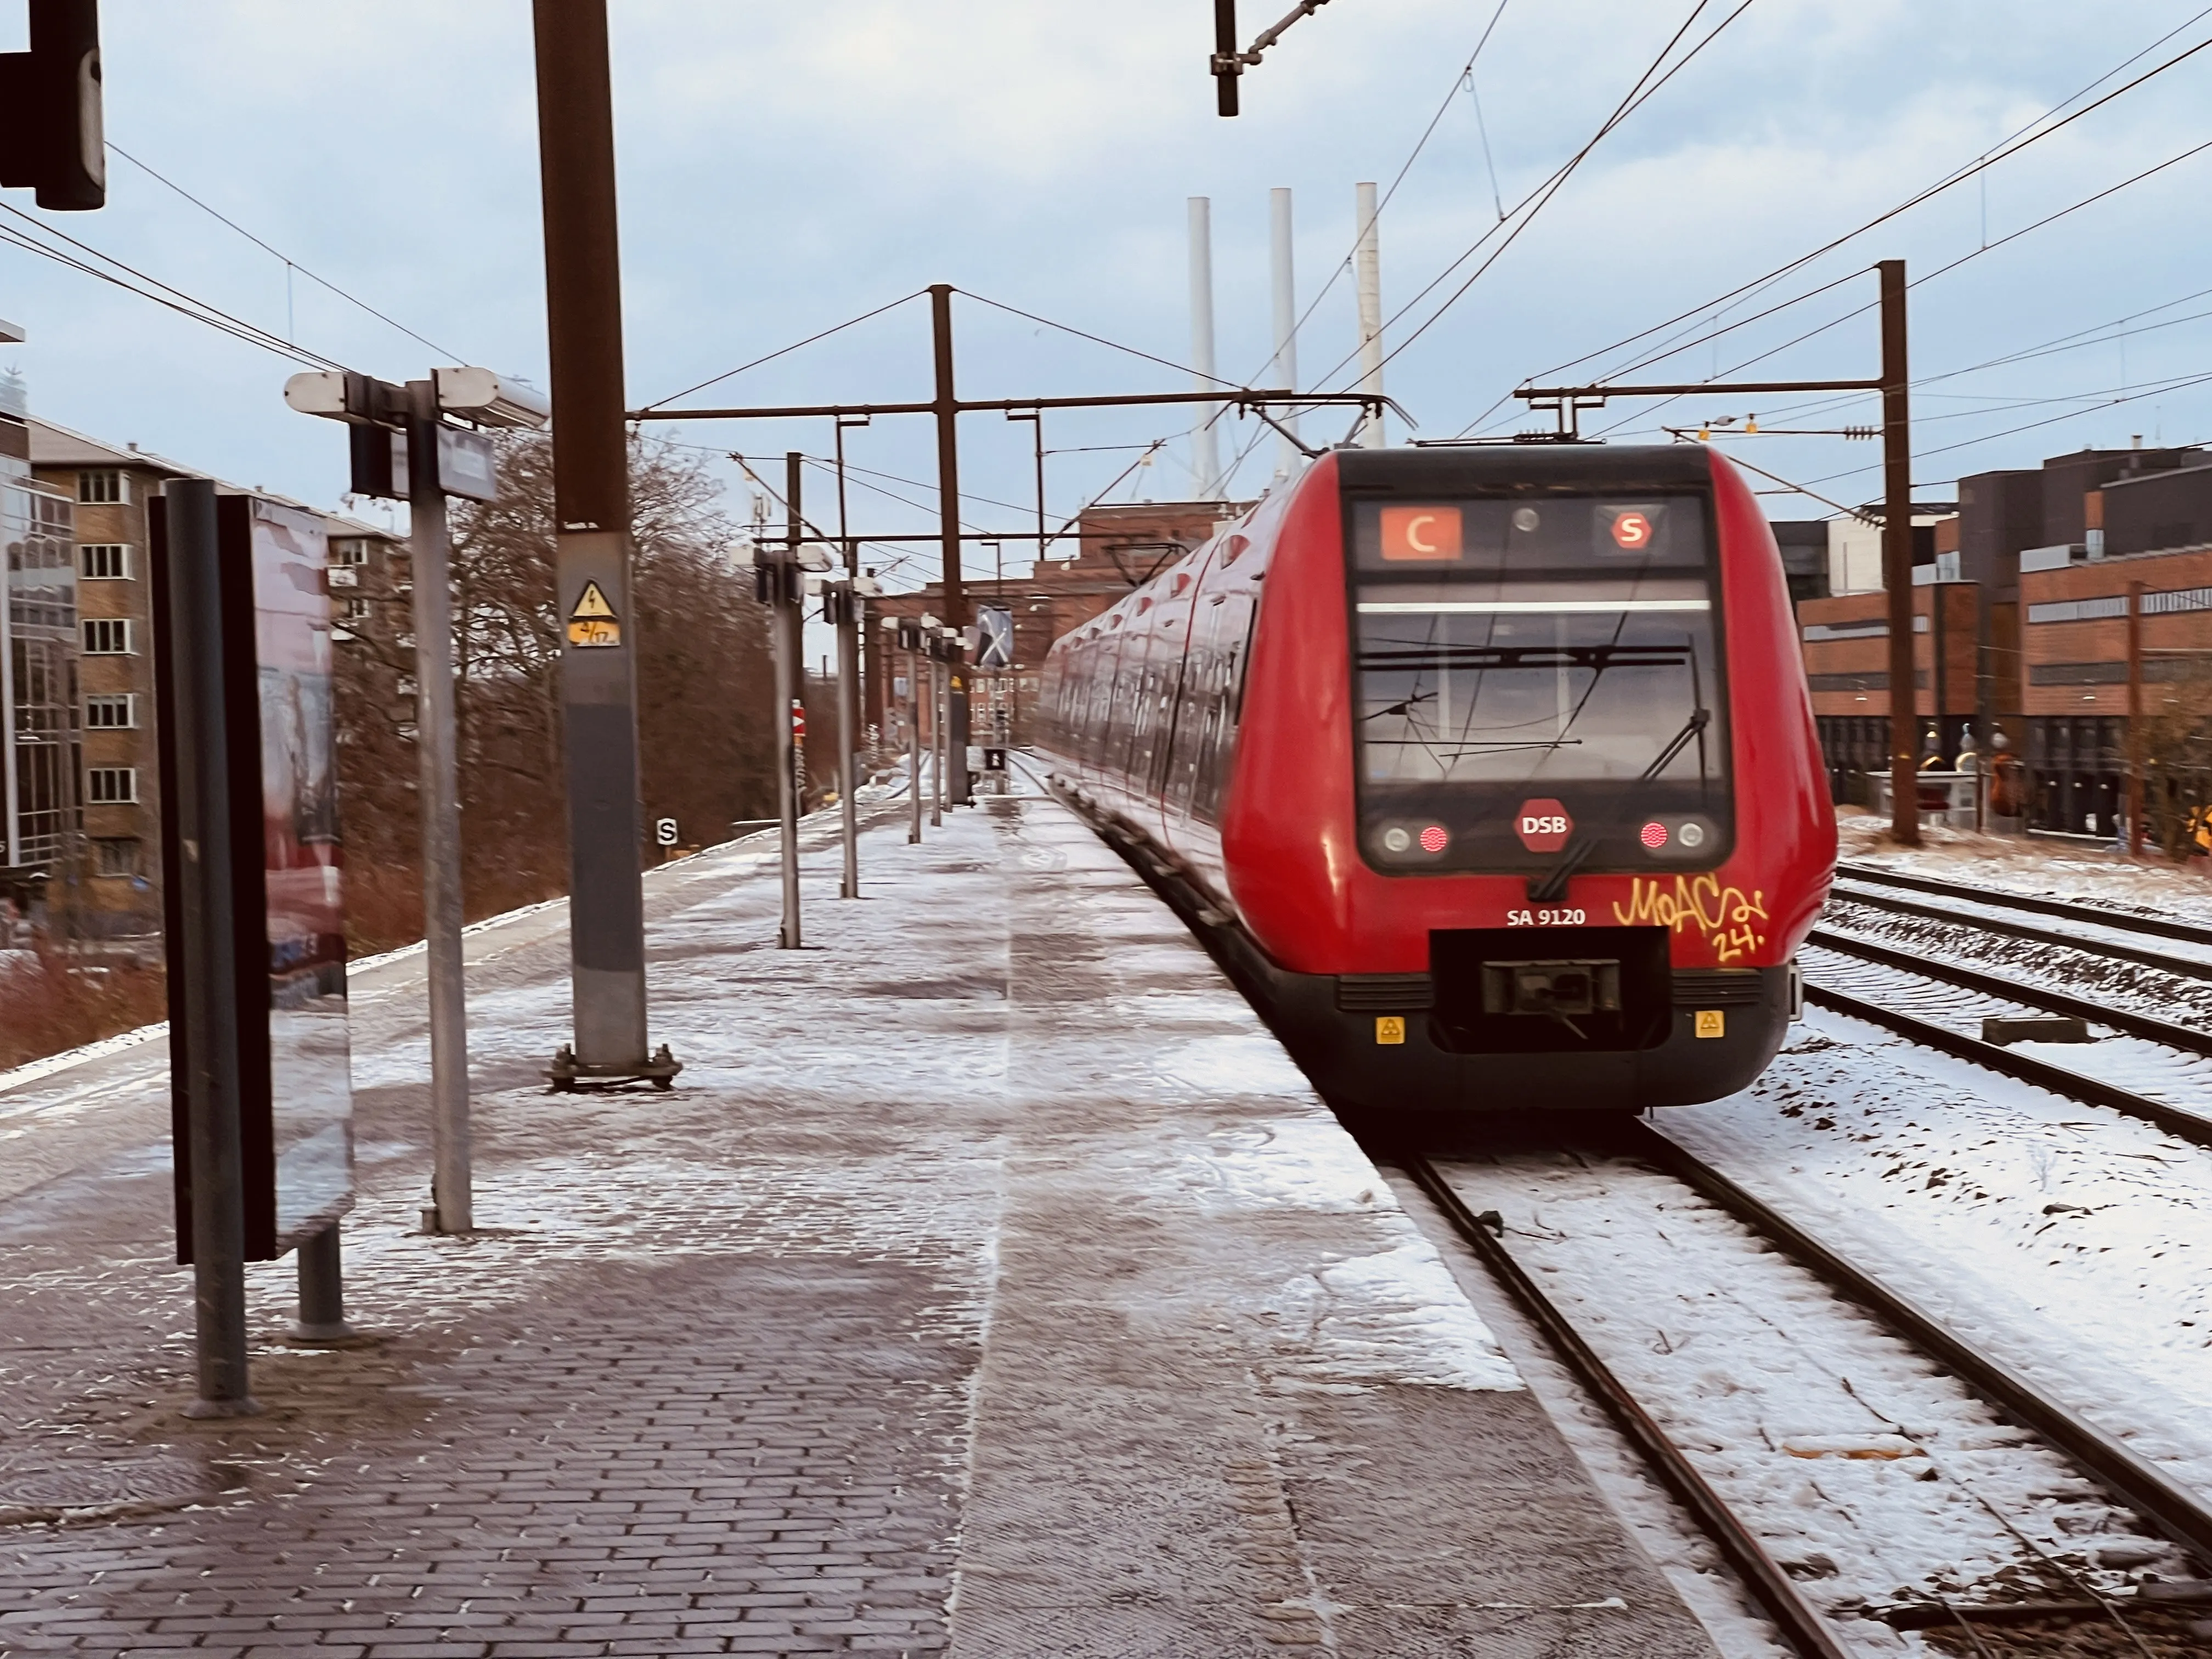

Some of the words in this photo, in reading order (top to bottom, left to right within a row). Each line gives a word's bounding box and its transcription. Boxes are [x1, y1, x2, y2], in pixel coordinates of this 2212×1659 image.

[1406, 516, 1436, 552] C
[1620, 518, 1643, 542] S
[660, 822, 675, 841] S
[1522, 816, 1567, 833] DSB
[1507, 910, 1534, 926] SA
[1538, 909, 1585, 926] 9120
